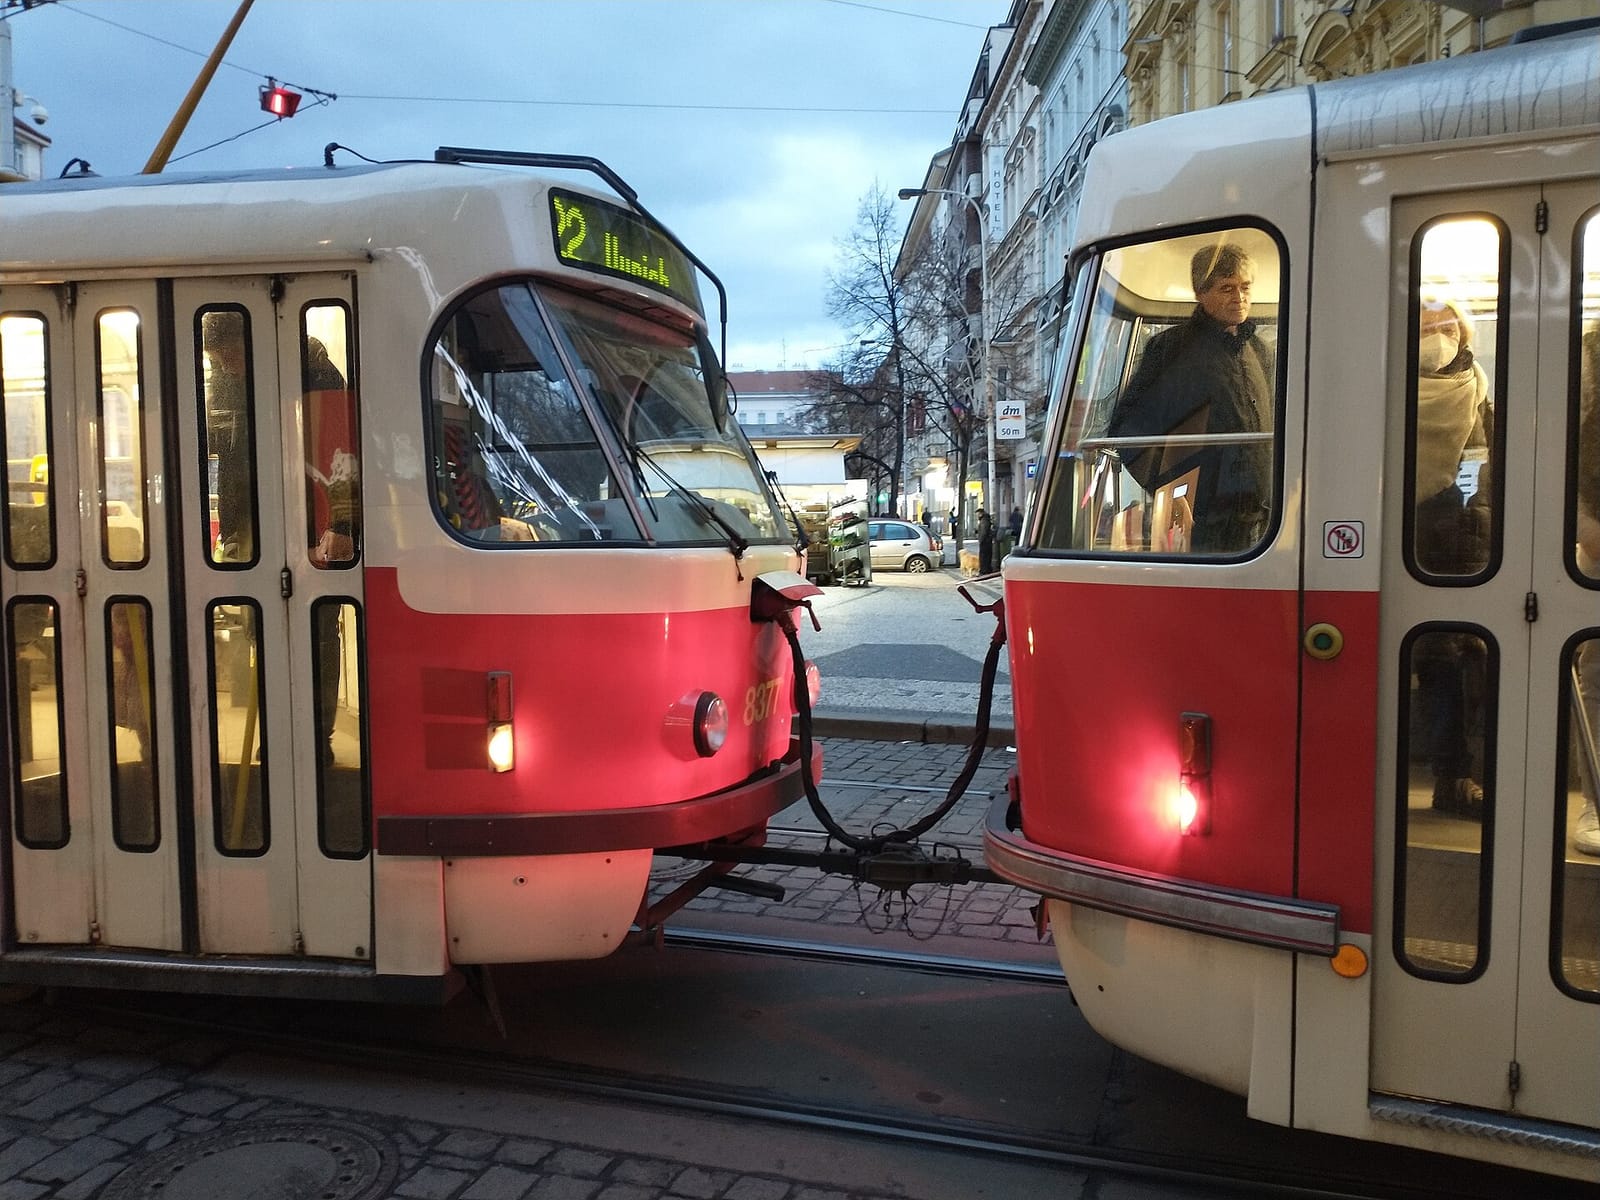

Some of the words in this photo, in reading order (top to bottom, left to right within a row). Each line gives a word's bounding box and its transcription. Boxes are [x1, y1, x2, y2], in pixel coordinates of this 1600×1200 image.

[993, 170, 1001, 222] HOTEL
[1002, 405, 1020, 415] dm
[1001, 427, 1011, 435] 50
[743, 677, 784, 726] 8377
